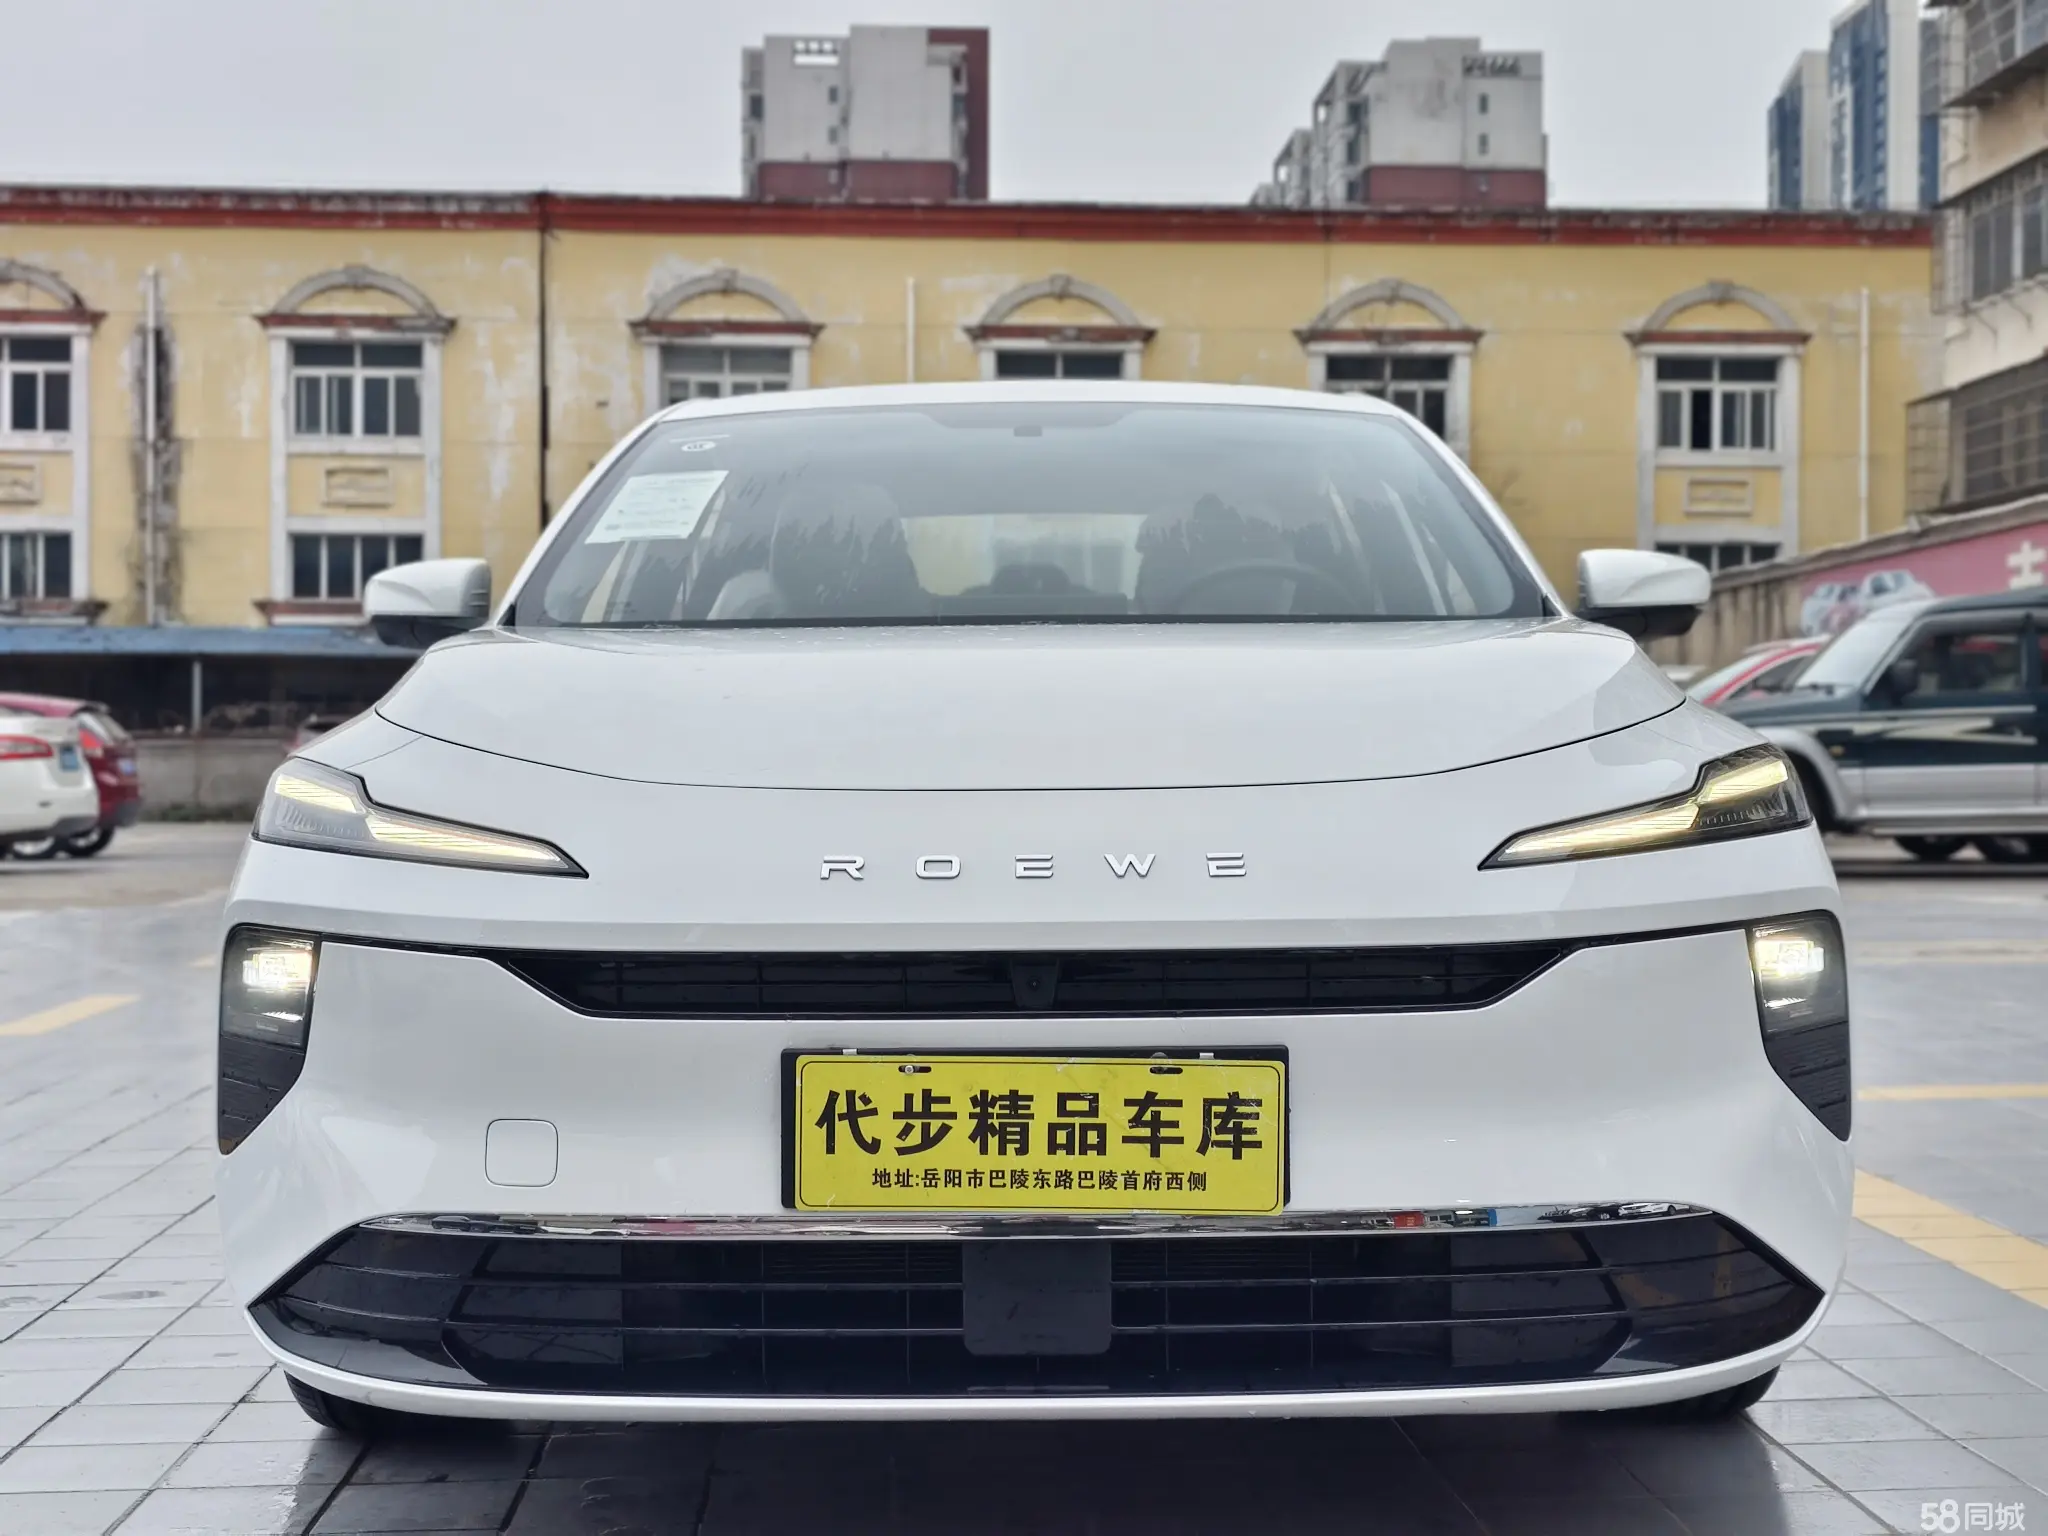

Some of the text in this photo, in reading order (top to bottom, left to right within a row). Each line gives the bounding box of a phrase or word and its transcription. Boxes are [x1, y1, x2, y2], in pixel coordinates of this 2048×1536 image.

[820, 852, 1247, 880] ROEWE
[815, 1088, 1264, 1161] 代步精品车库
